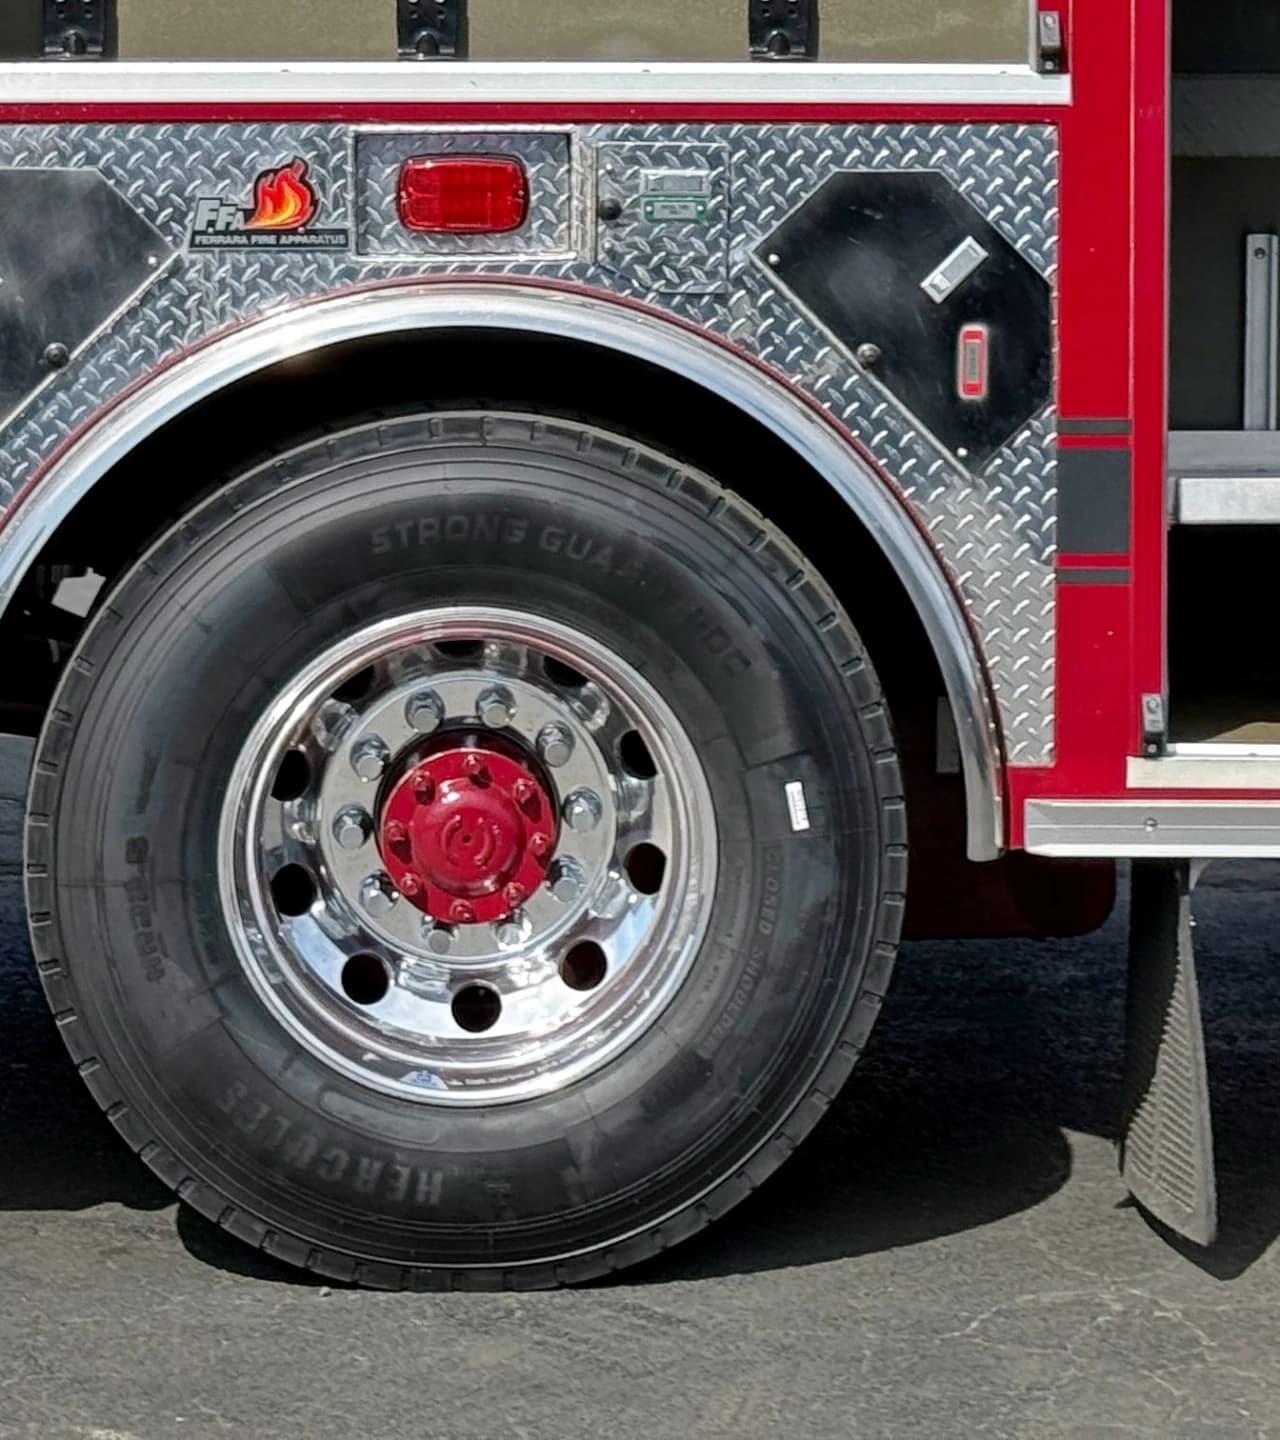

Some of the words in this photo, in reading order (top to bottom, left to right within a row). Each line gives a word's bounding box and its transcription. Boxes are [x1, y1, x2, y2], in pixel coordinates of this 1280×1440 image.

[193, 234, 249, 246] FERRARA
[250, 234, 276, 246] FIRE
[278, 233, 347, 246] APPARATUS
[370, 514, 530, 556] STRONG
[220, 1081, 446, 1206] HERCULES
